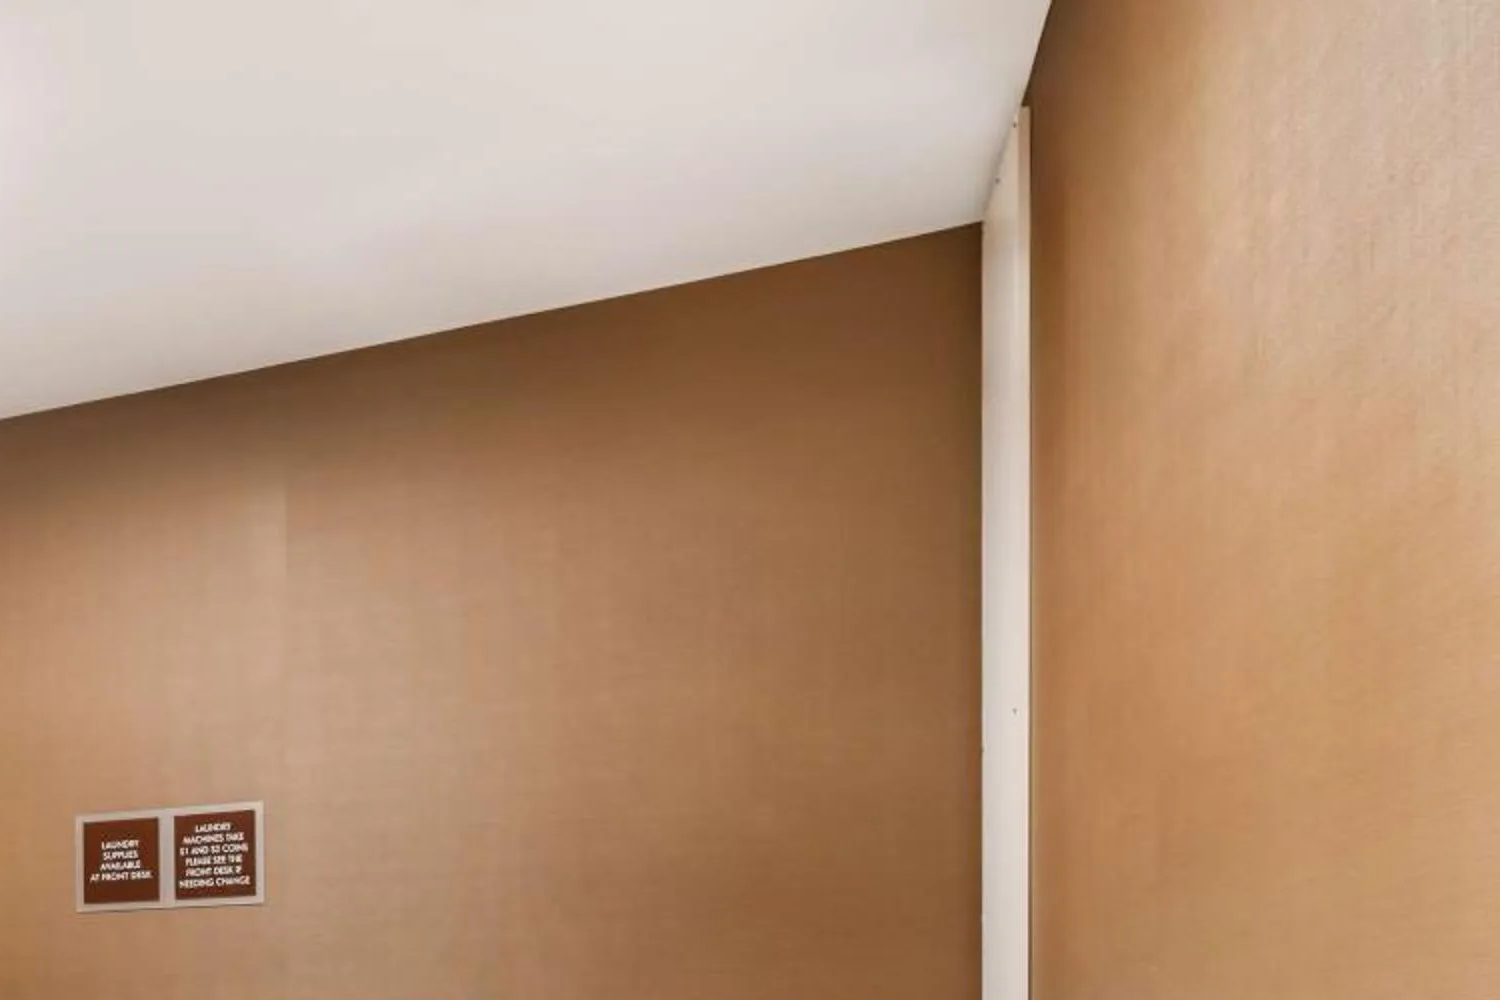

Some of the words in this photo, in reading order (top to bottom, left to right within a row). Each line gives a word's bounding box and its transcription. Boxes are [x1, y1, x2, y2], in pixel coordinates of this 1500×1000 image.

[194, 822, 231, 833] LAUNDRY
[101, 839, 140, 850] LAUNDRY
[103, 850, 139, 861] SUPPLIES
[100, 860, 141, 871] AVAILABLE
[90, 873, 100, 882] AT
[101, 871, 129, 881] FRONT
